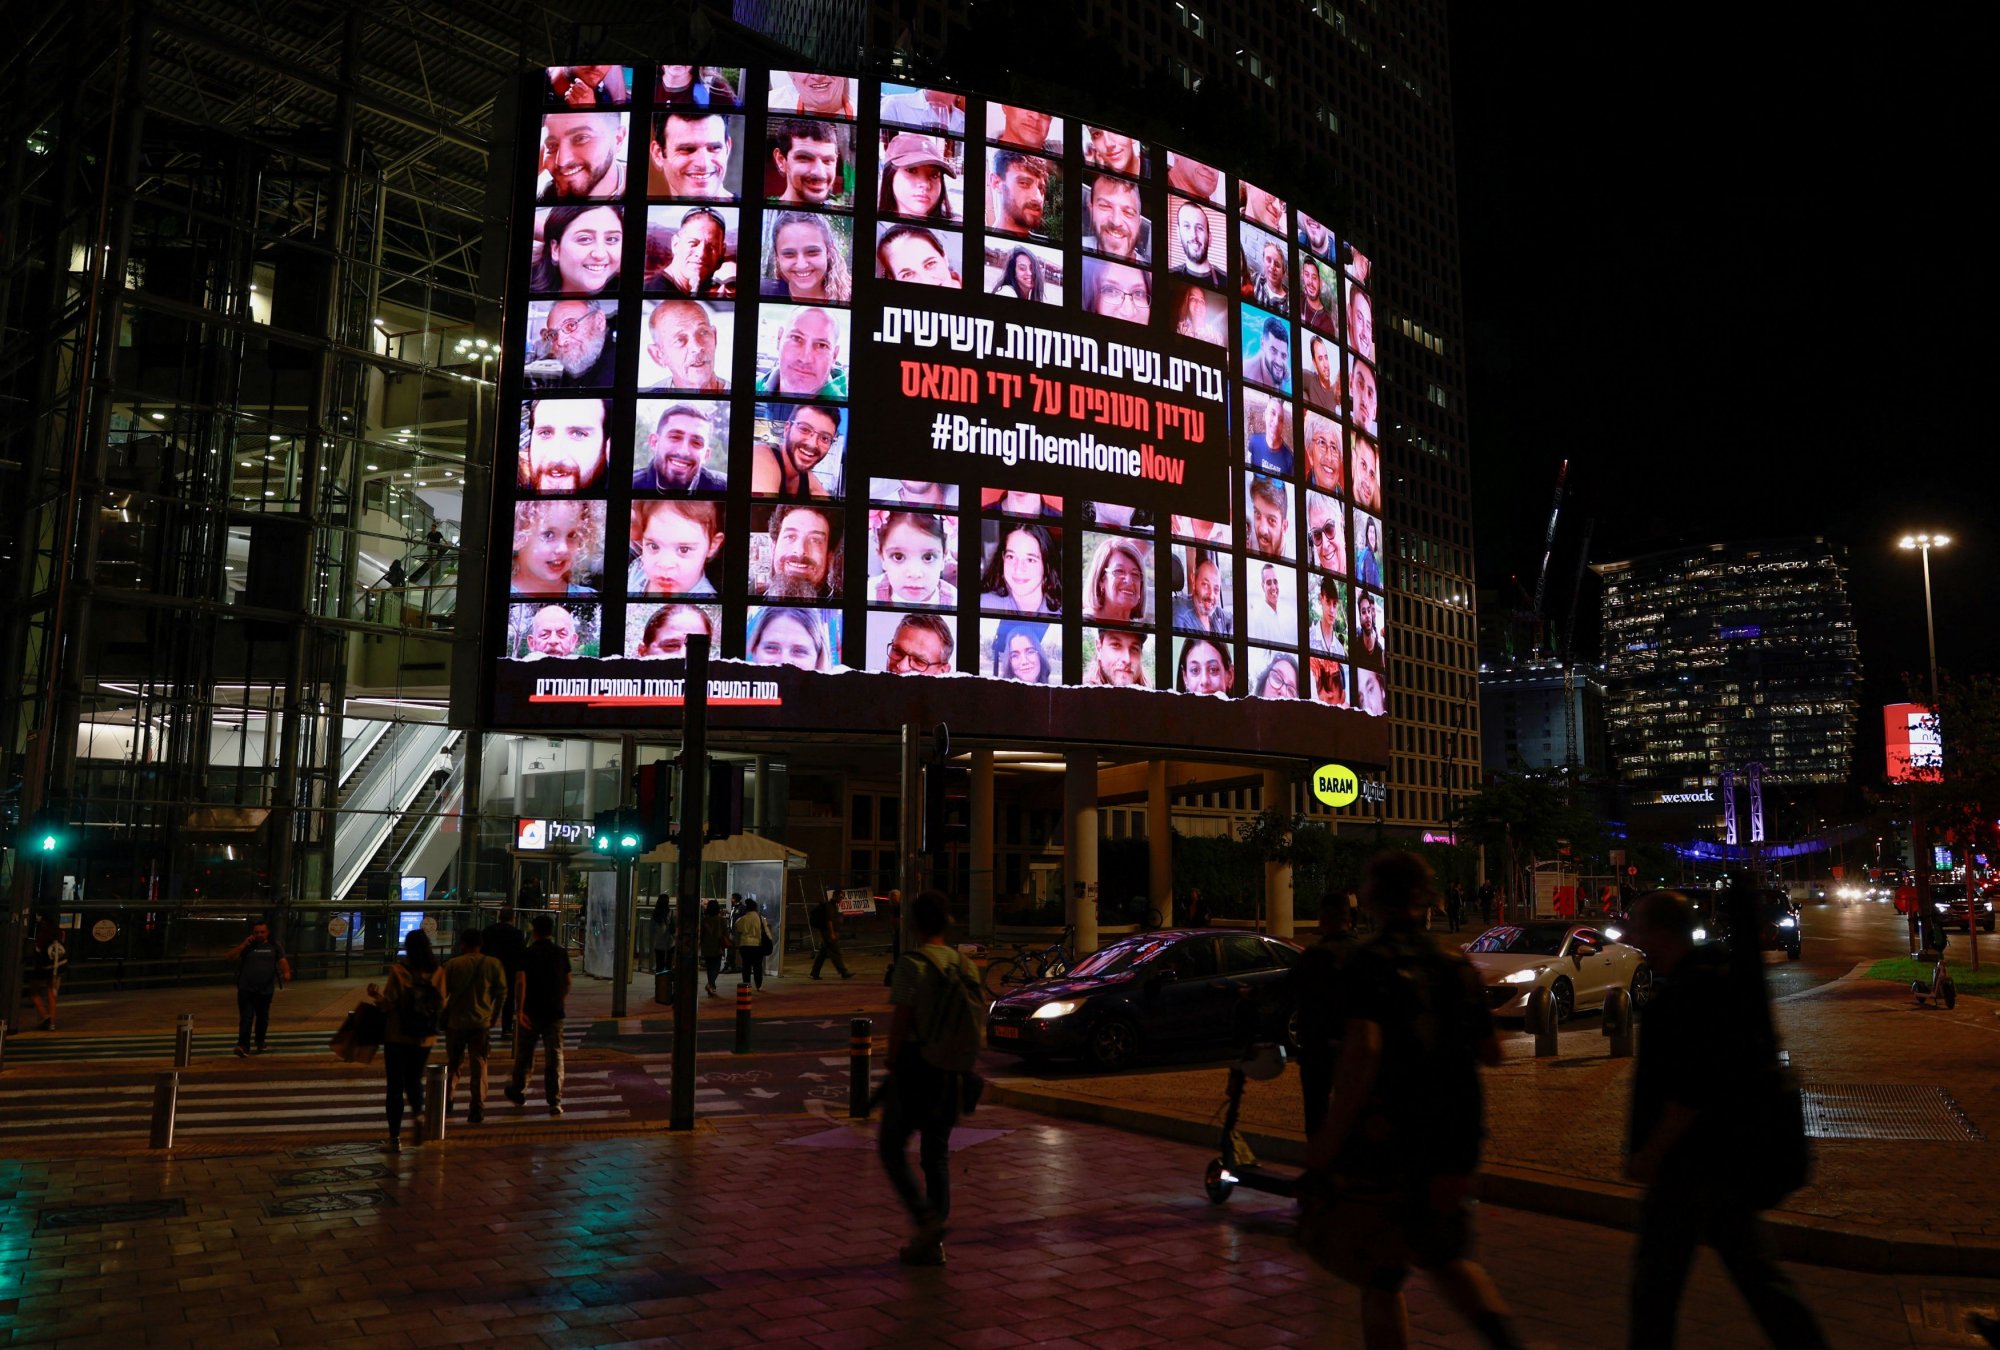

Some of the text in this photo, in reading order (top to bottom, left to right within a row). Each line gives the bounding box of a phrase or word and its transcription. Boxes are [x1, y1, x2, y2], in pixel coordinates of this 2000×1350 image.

[900, 360, 1205, 443] עדיין חטופים על ידי חמאס
[931, 412, 1185, 485] #BringThemHomeNow
[536, 678, 588, 697] והנעדרים
[591, 678, 642, 697] החטופים
[752, 681, 778, 699] מטה
[1319, 776, 1353, 794] BARAM
[548, 820, 581, 842] קפלן
